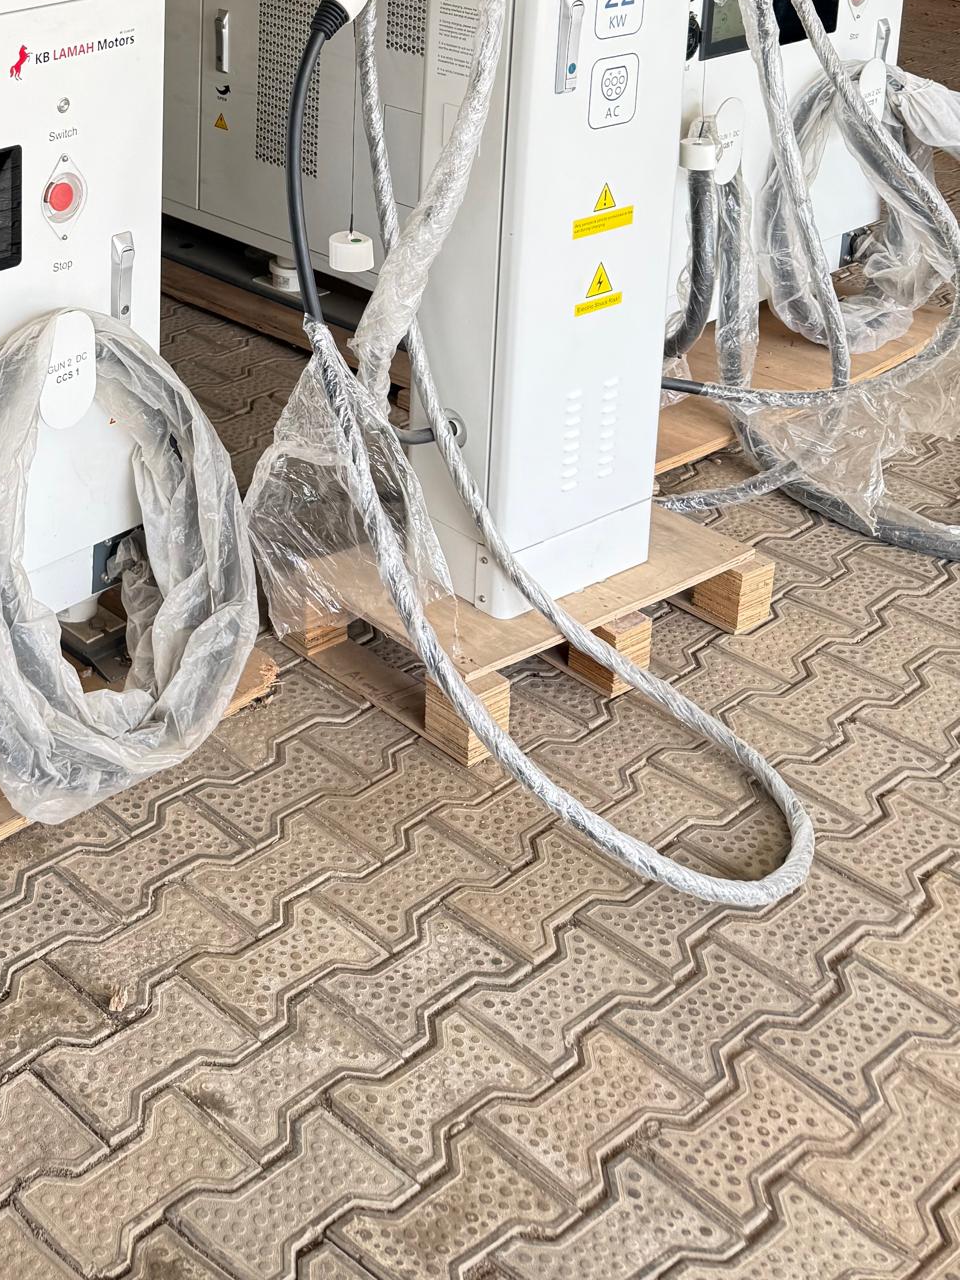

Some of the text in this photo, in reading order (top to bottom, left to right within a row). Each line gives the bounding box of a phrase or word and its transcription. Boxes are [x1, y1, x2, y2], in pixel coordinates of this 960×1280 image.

[608, 14, 628, 30] KW
[35, 35, 135, 65] KB LAMAH Motors
[604, 105, 620, 119] AC
[48, 127, 78, 142] Switch
[52, 260, 73, 273] Stop
[48, 351, 87, 375] GUN 2 DC
[56, 370, 73, 384] CCS
